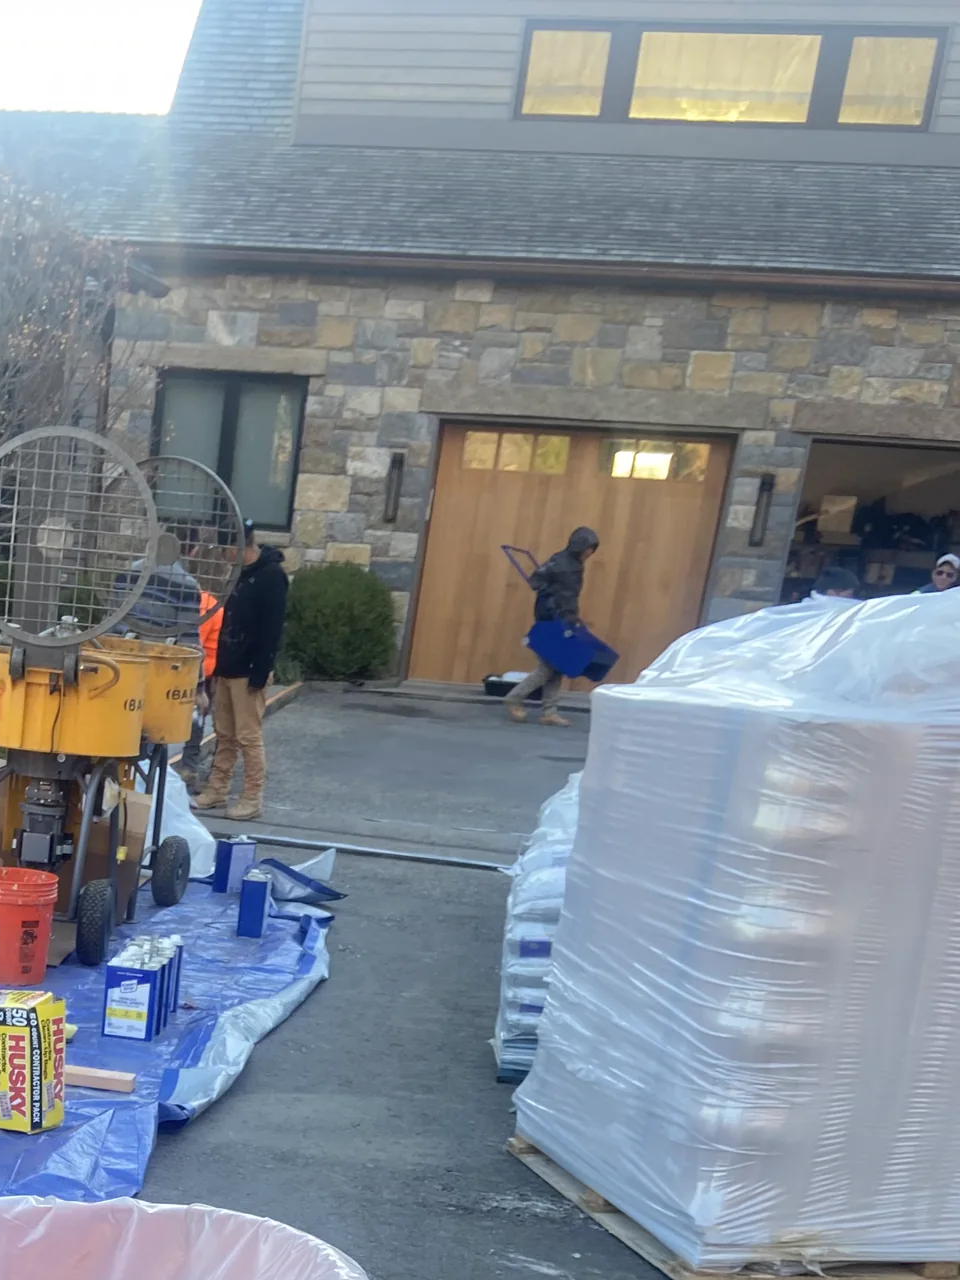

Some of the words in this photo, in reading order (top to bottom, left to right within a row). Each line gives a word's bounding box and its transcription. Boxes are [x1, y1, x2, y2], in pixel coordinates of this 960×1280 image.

[11, 1008, 28, 1026] 50
[8, 1034, 27, 1118] HUSKY
[32, 1049, 41, 1101] CONTRACTOR
[52, 1017, 64, 1102] HUSKY
[32, 1102, 40, 1123] PACK
